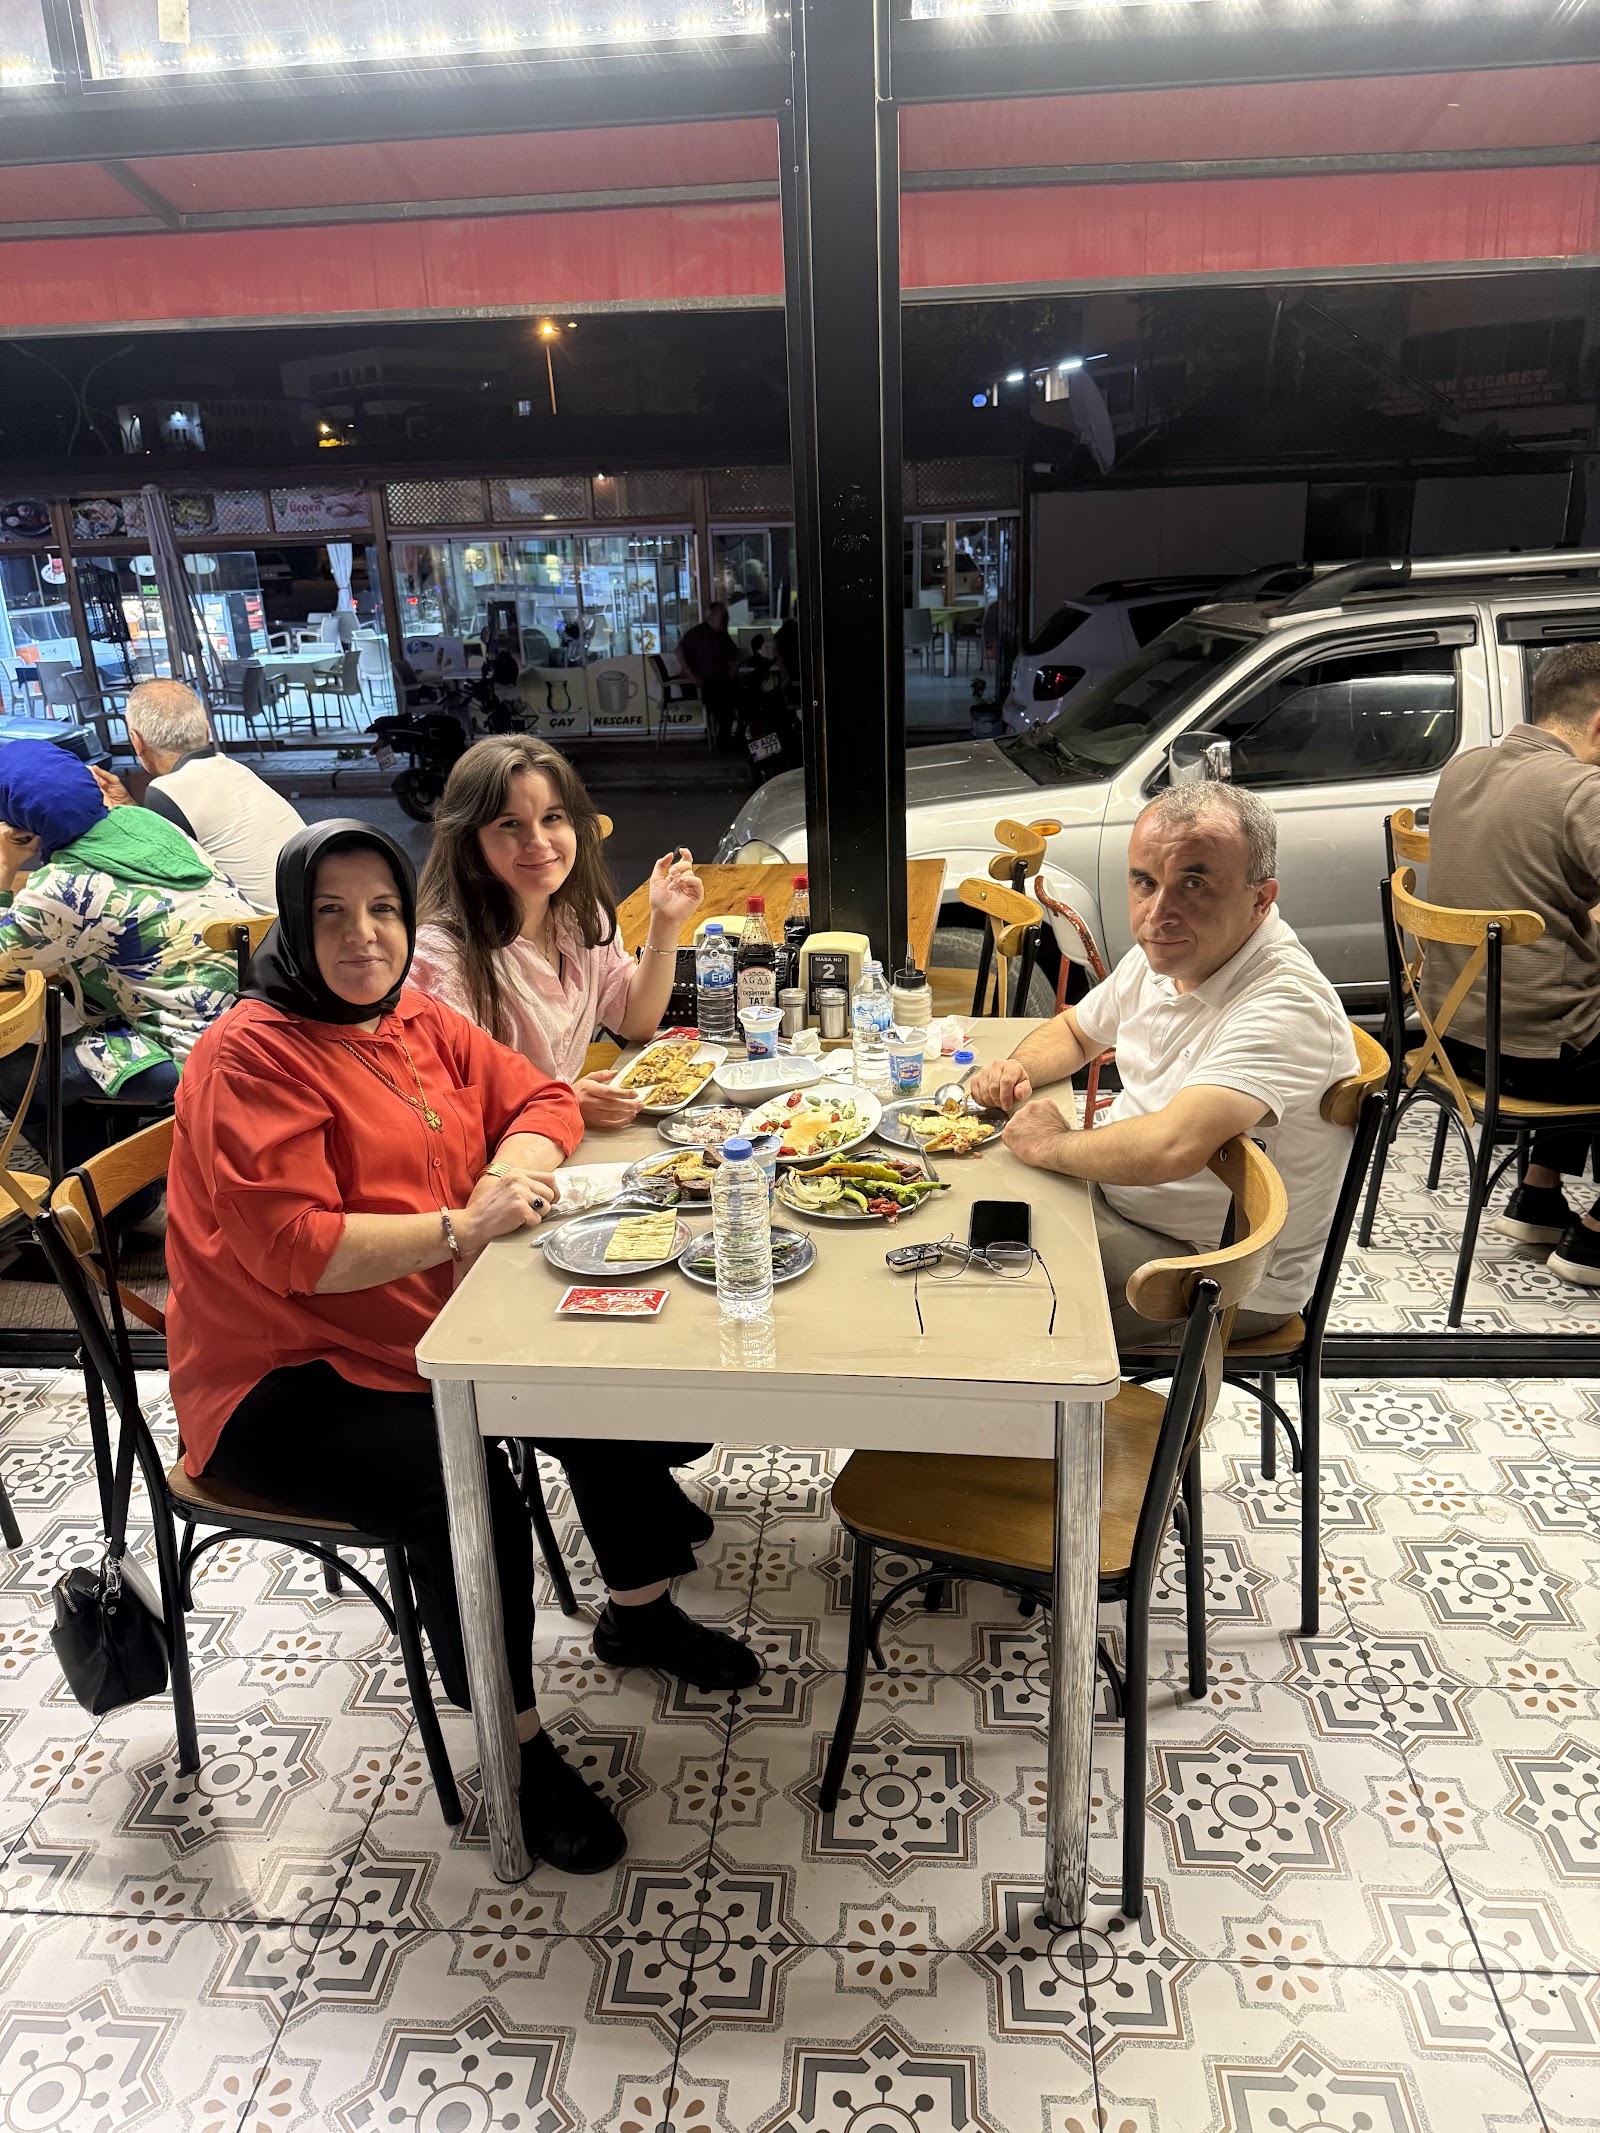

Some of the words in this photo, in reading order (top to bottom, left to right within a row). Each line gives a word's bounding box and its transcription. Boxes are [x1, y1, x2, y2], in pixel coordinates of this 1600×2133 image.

[549, 717, 575, 729] ÇAY
[593, 715, 643, 726] NESCAFE
[822, 963, 836, 979] 2
[749, 997, 765, 1005] TAT
